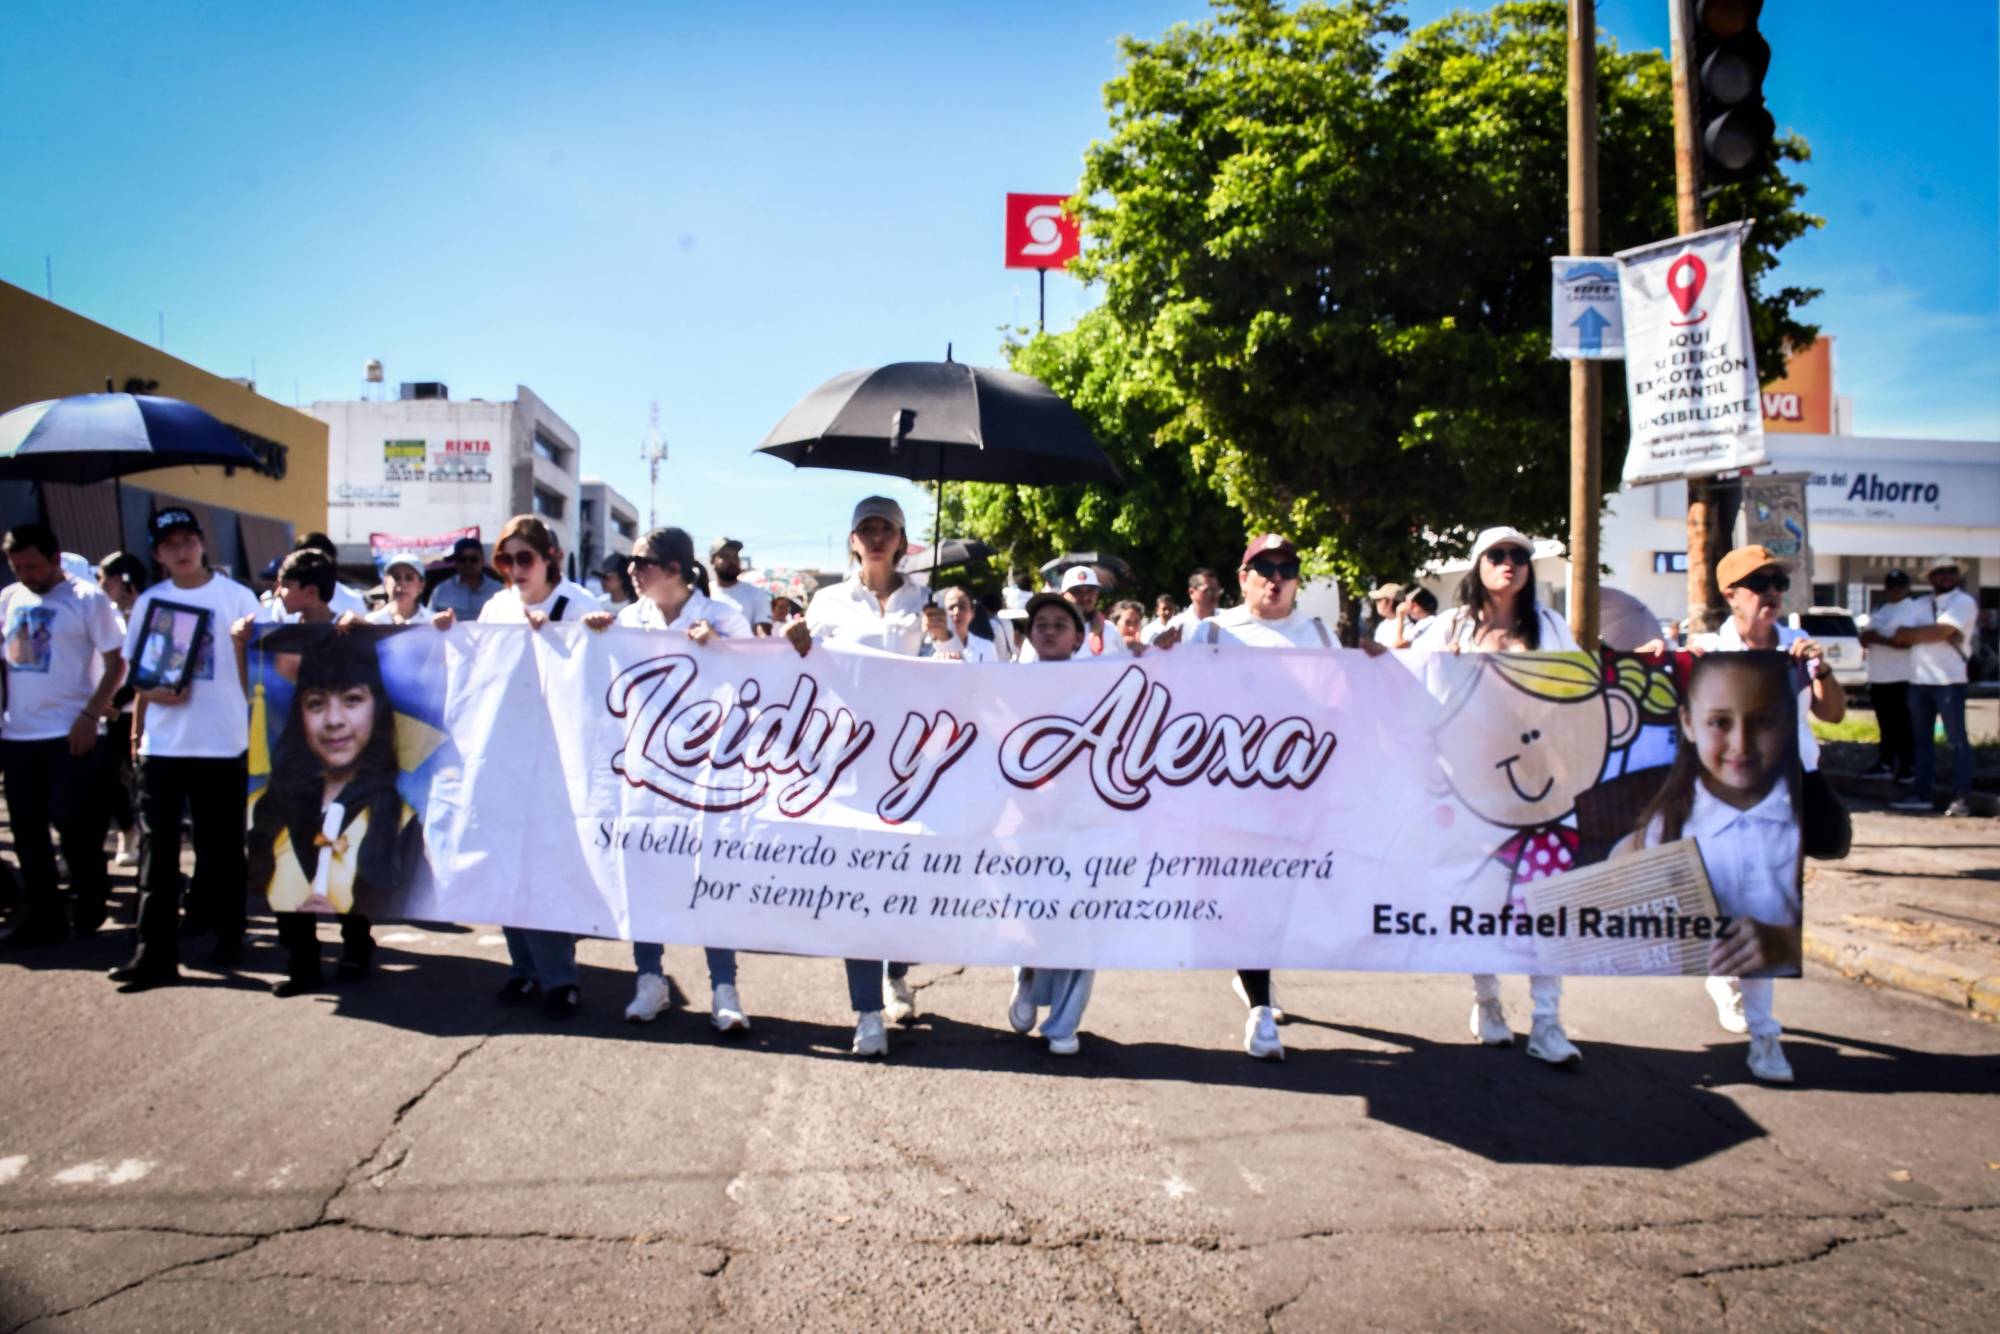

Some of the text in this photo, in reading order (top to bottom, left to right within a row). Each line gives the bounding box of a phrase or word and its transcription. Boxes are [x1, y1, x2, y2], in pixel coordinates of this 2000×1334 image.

[1671, 343, 1728, 365] EJERCE
[1636, 357, 1749, 395] EXOTACIÓN
[1656, 381, 1728, 402] NFANTIL
[445, 439, 493, 454] RENTA
[1848, 472, 1940, 503] Ahorro
[606, 653, 1338, 824] Leidy y Alexa
[595, 821, 1335, 888] Su bello recuerdo será un tesoro, que permanecerá
[690, 873, 1224, 921] por siempre, en nuestros corazones.
[1373, 904, 1438, 936] Esc.
[1451, 905, 1567, 938] Rafael
